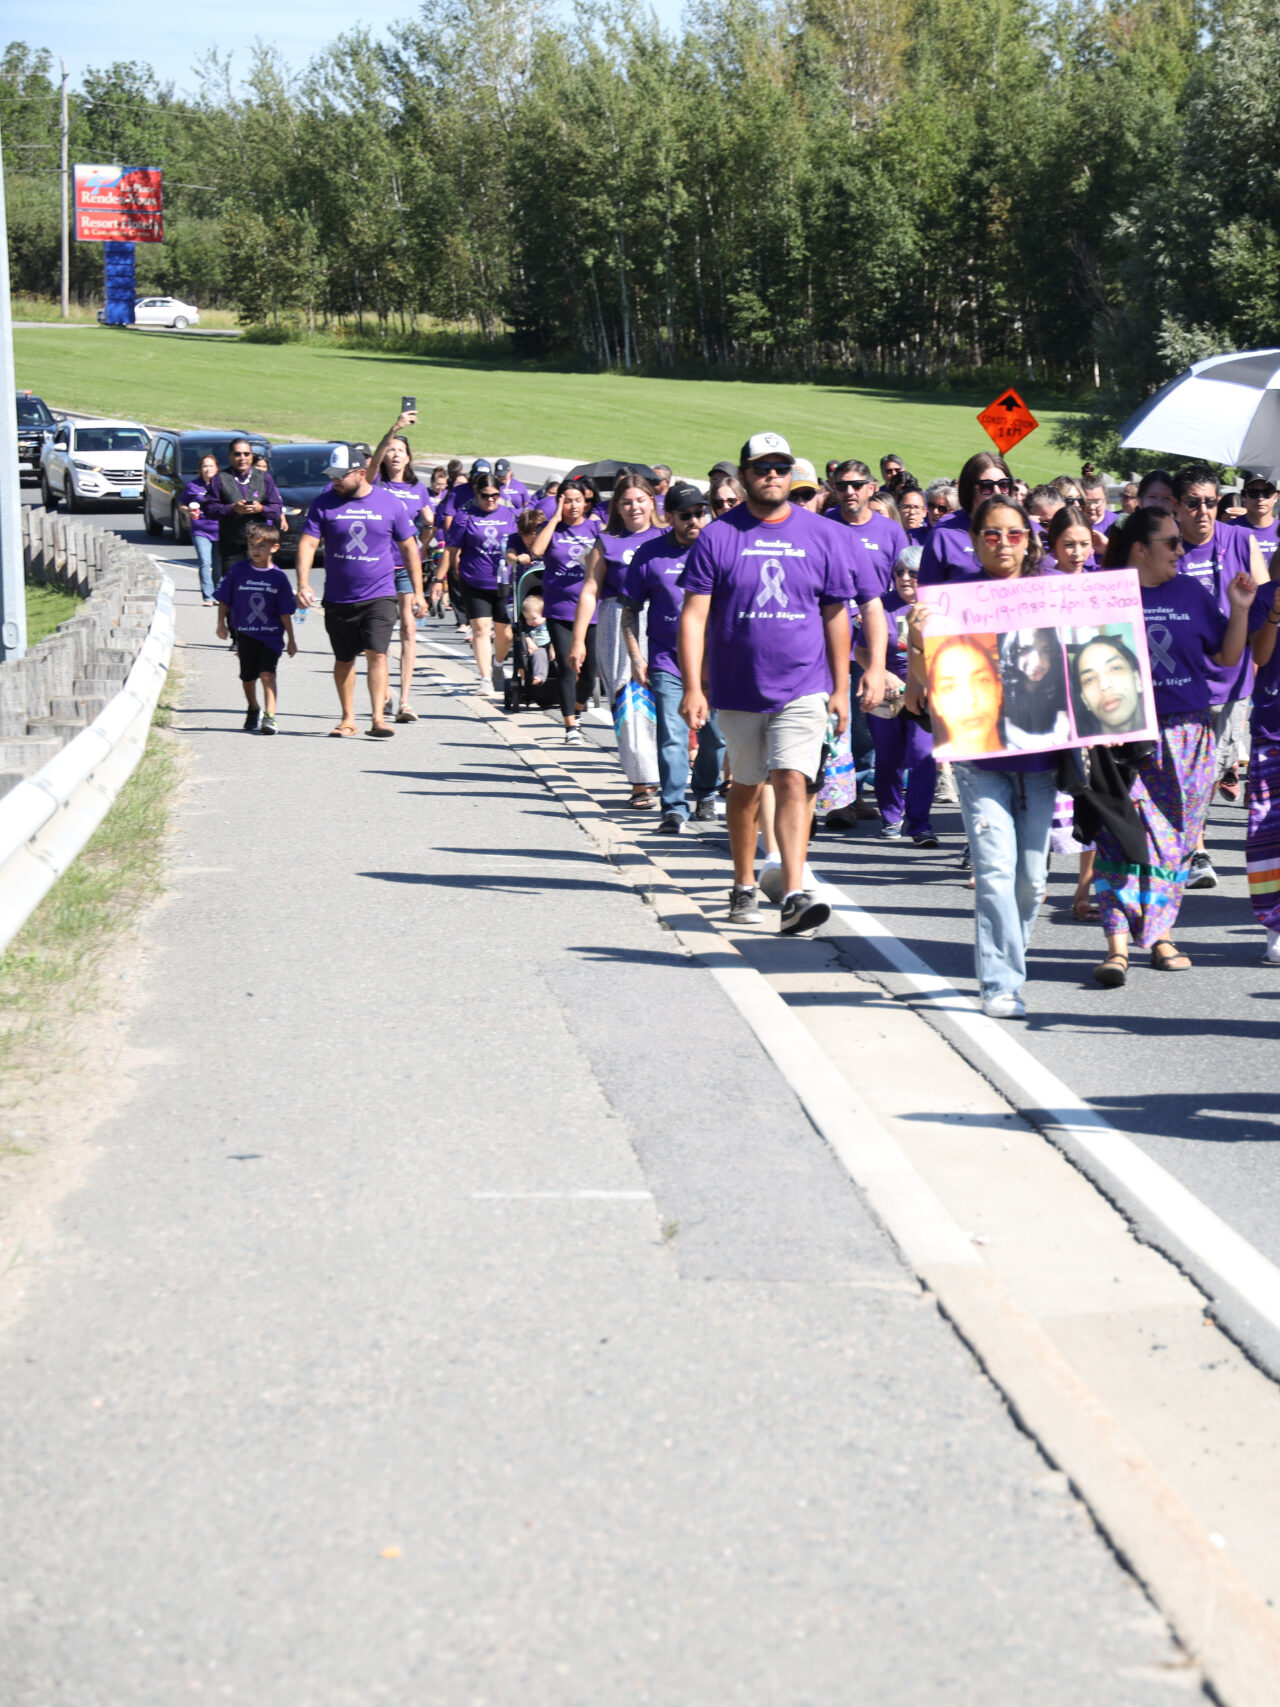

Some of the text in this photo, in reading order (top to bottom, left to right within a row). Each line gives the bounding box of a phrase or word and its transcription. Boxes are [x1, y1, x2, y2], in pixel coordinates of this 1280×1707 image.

[133, 183, 155, 193] Place
[81, 191, 158, 206] Rendez-Vous
[81, 215, 152, 230] Resort Hotel
[1168, 613, 1191, 621] Walk
